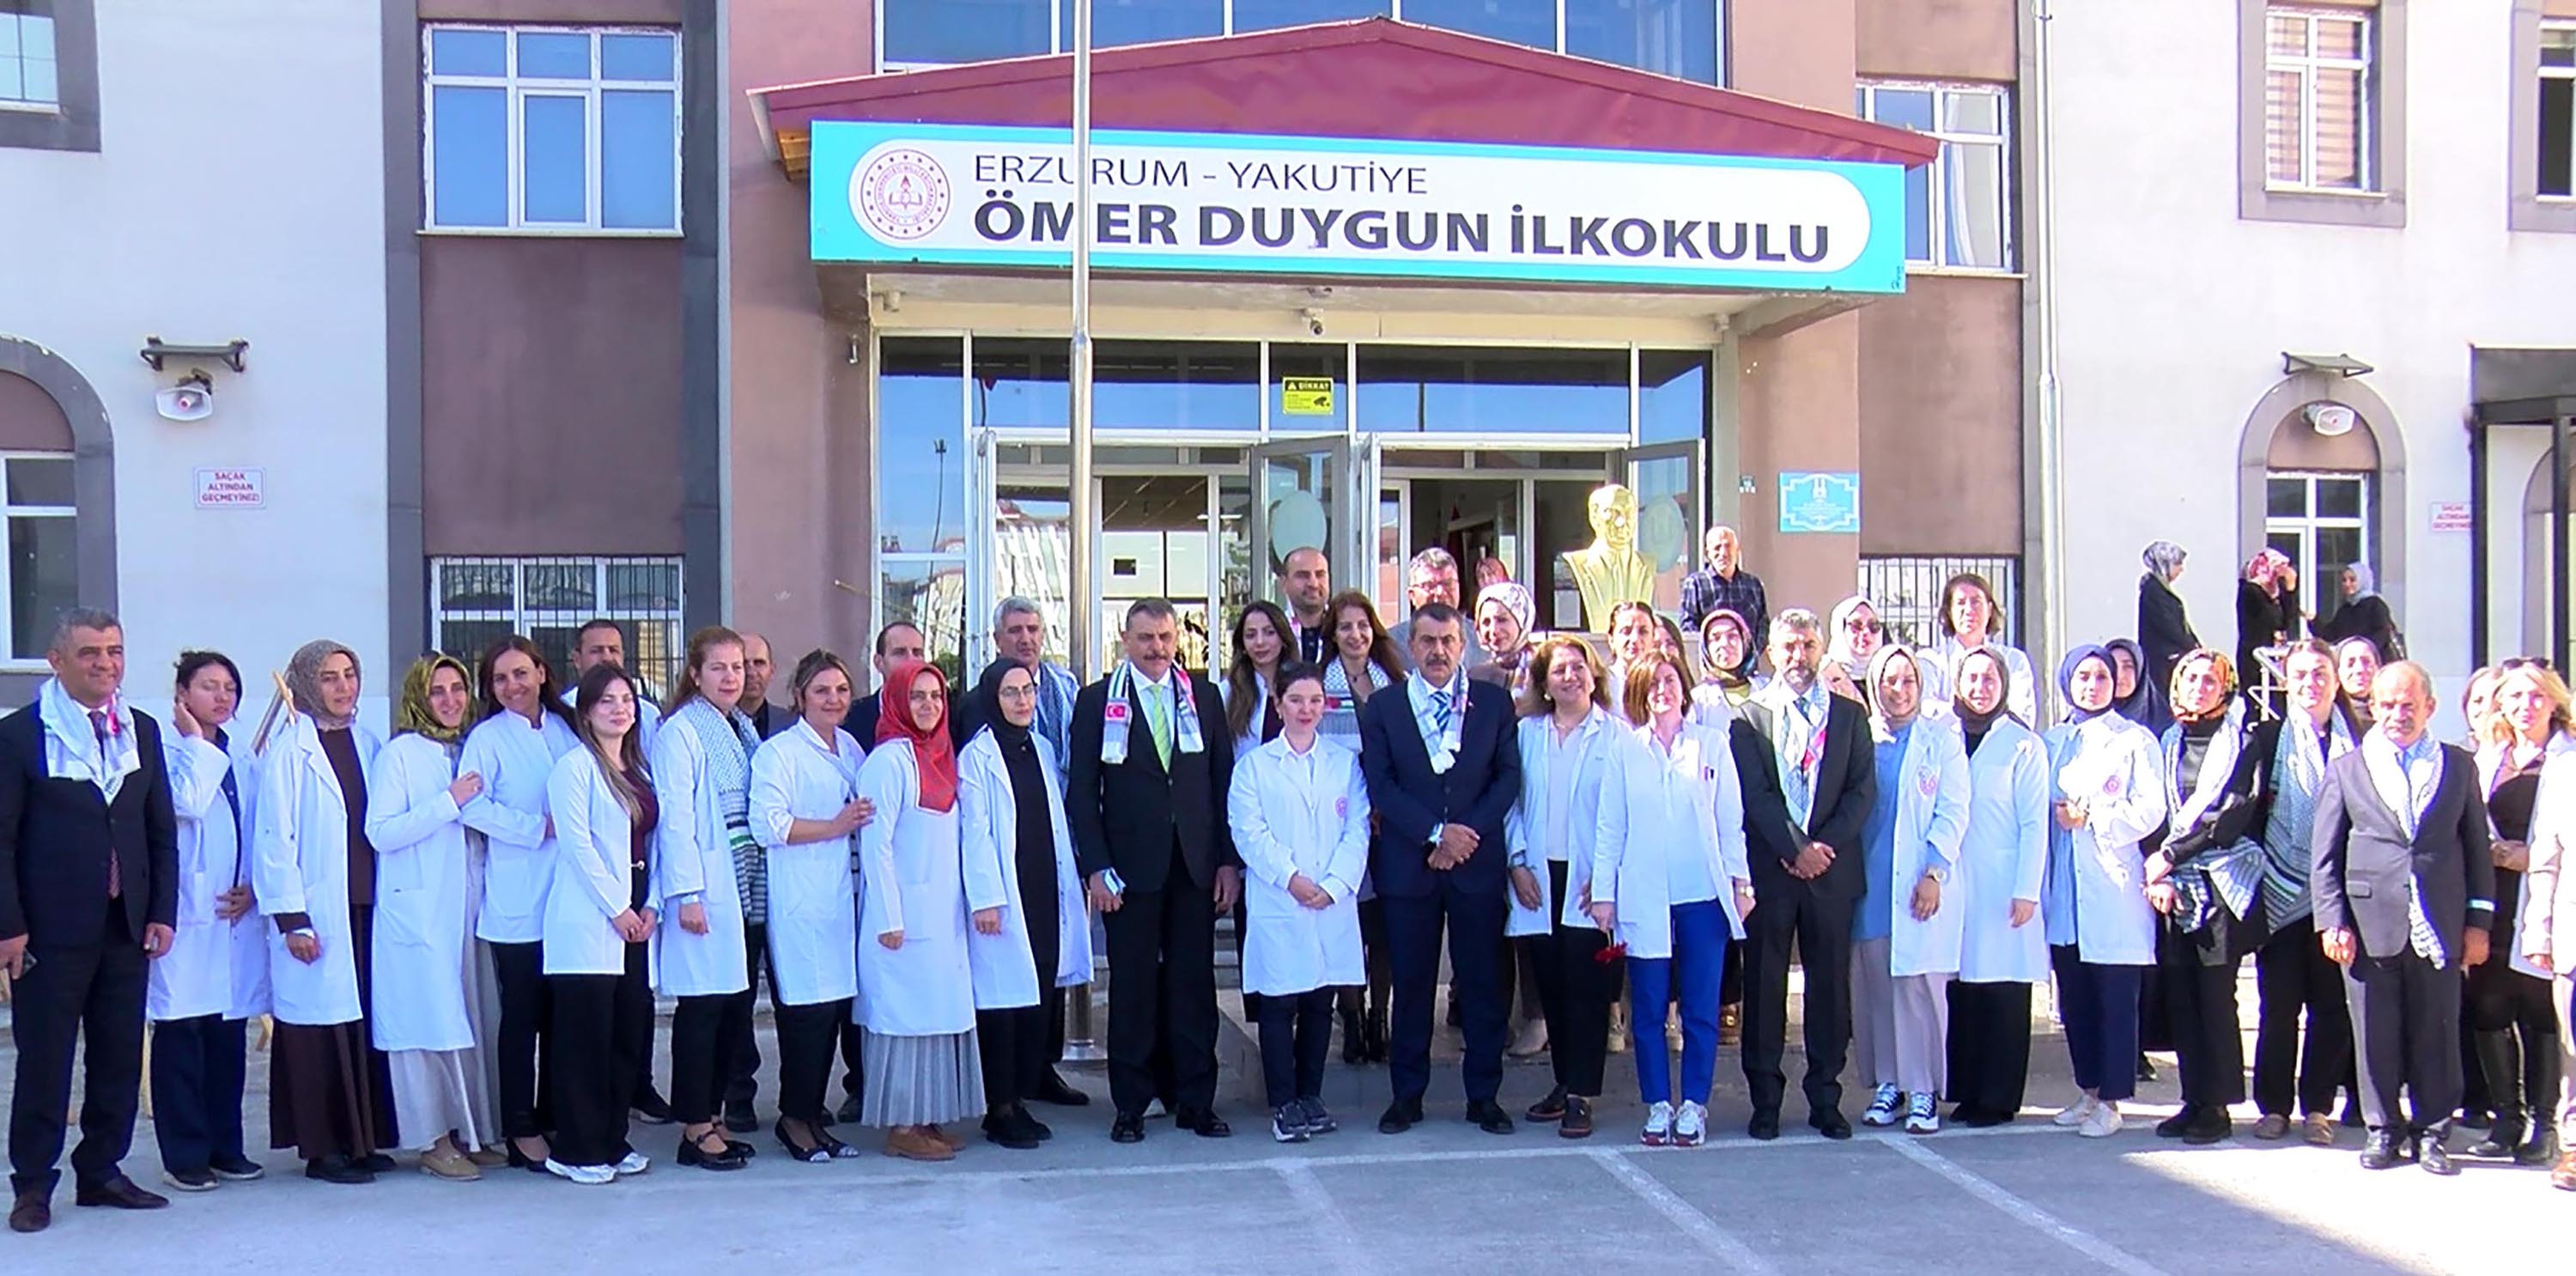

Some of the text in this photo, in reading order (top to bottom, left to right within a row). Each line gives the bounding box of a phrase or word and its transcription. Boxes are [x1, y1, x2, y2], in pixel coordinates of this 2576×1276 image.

[975, 155, 1188, 187] ERZURUM
[1227, 160, 1427, 194] YAKUTİYE
[974, 189, 1178, 245] ÖMER
[1199, 206, 1489, 252] DUYGUN
[1510, 204, 1829, 263] İLKOKULU
[216, 472, 246, 481] SAÇAK
